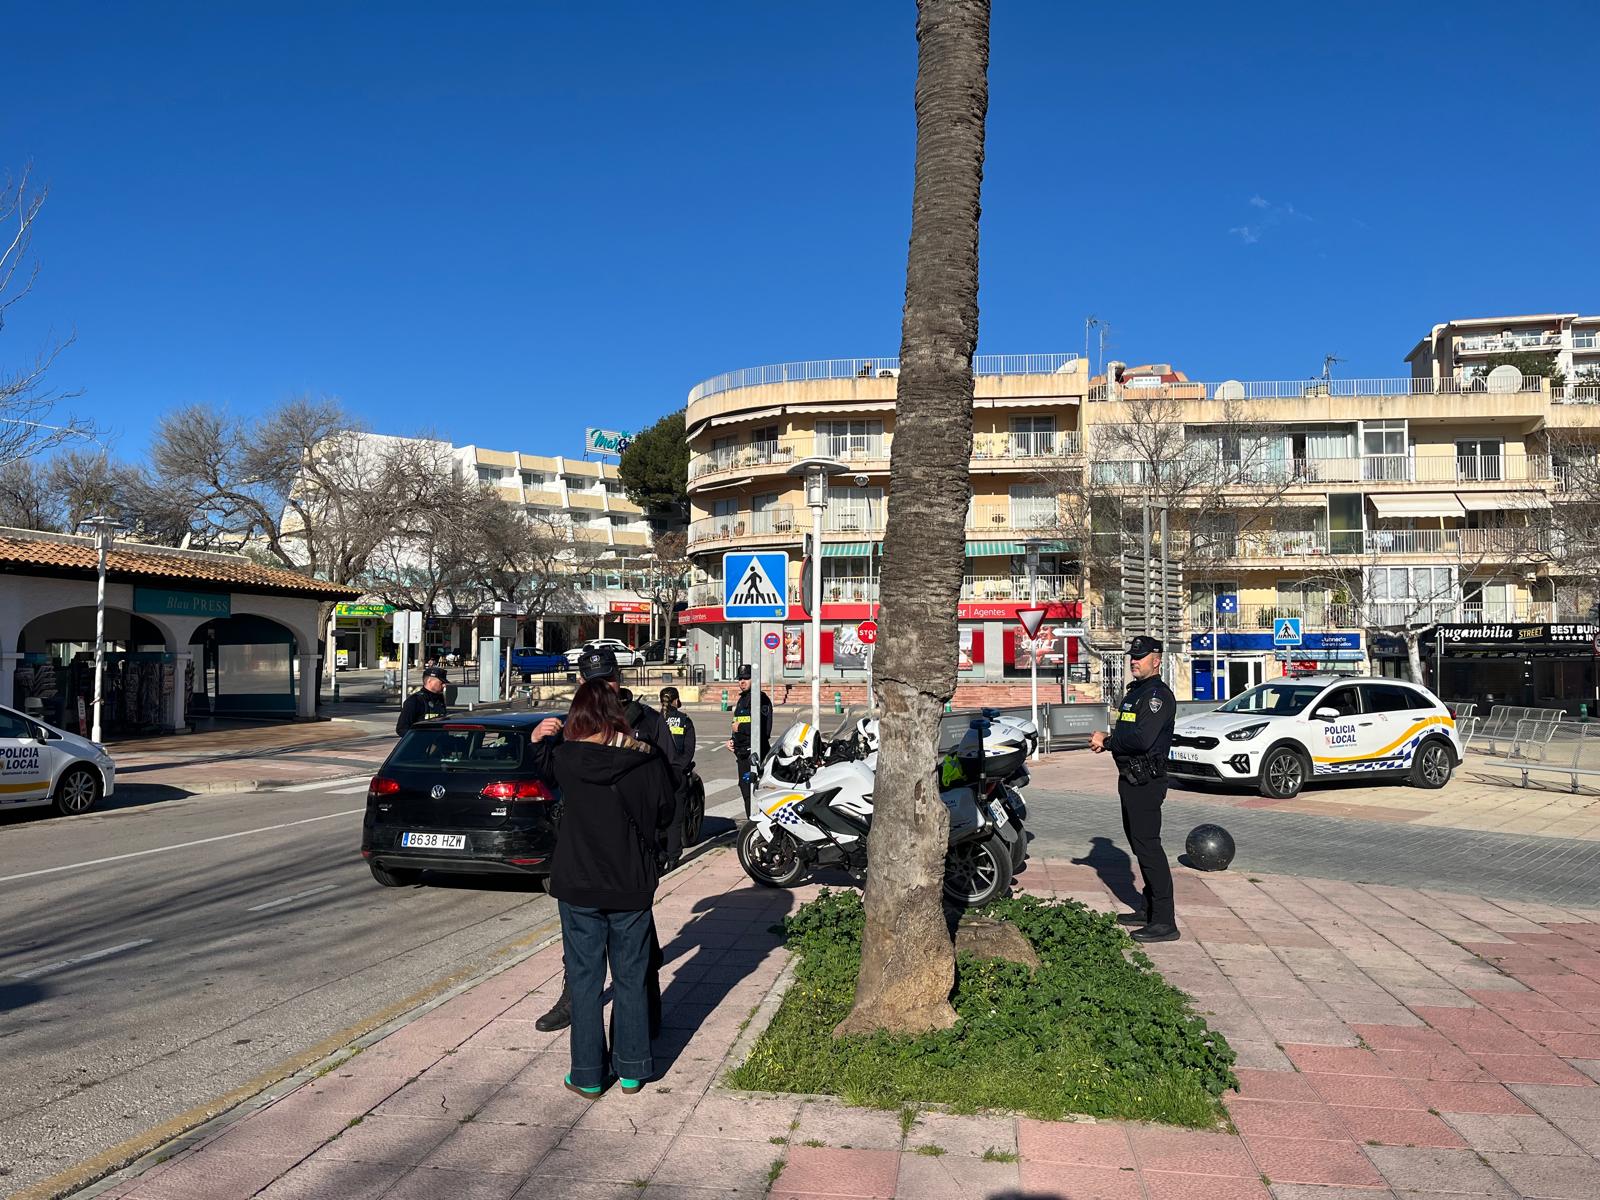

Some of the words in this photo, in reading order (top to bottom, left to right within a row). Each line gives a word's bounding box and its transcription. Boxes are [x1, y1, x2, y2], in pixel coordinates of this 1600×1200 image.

[166, 596, 189, 609] Blau
[192, 597, 228, 612] PRESS
[973, 608, 1006, 618] Agentes
[1434, 625, 1513, 641] Bugambilia
[1519, 627, 1543, 639] STREET
[1550, 625, 1575, 634] BEST
[1324, 724, 1356, 735] POLICIA
[1331, 734, 1357, 744] LOCAL
[0, 747, 39, 759] POLICIA
[6, 759, 39, 770] LOCAL
[409, 834, 438, 846] 8638
[442, 835, 463, 847] HZW
